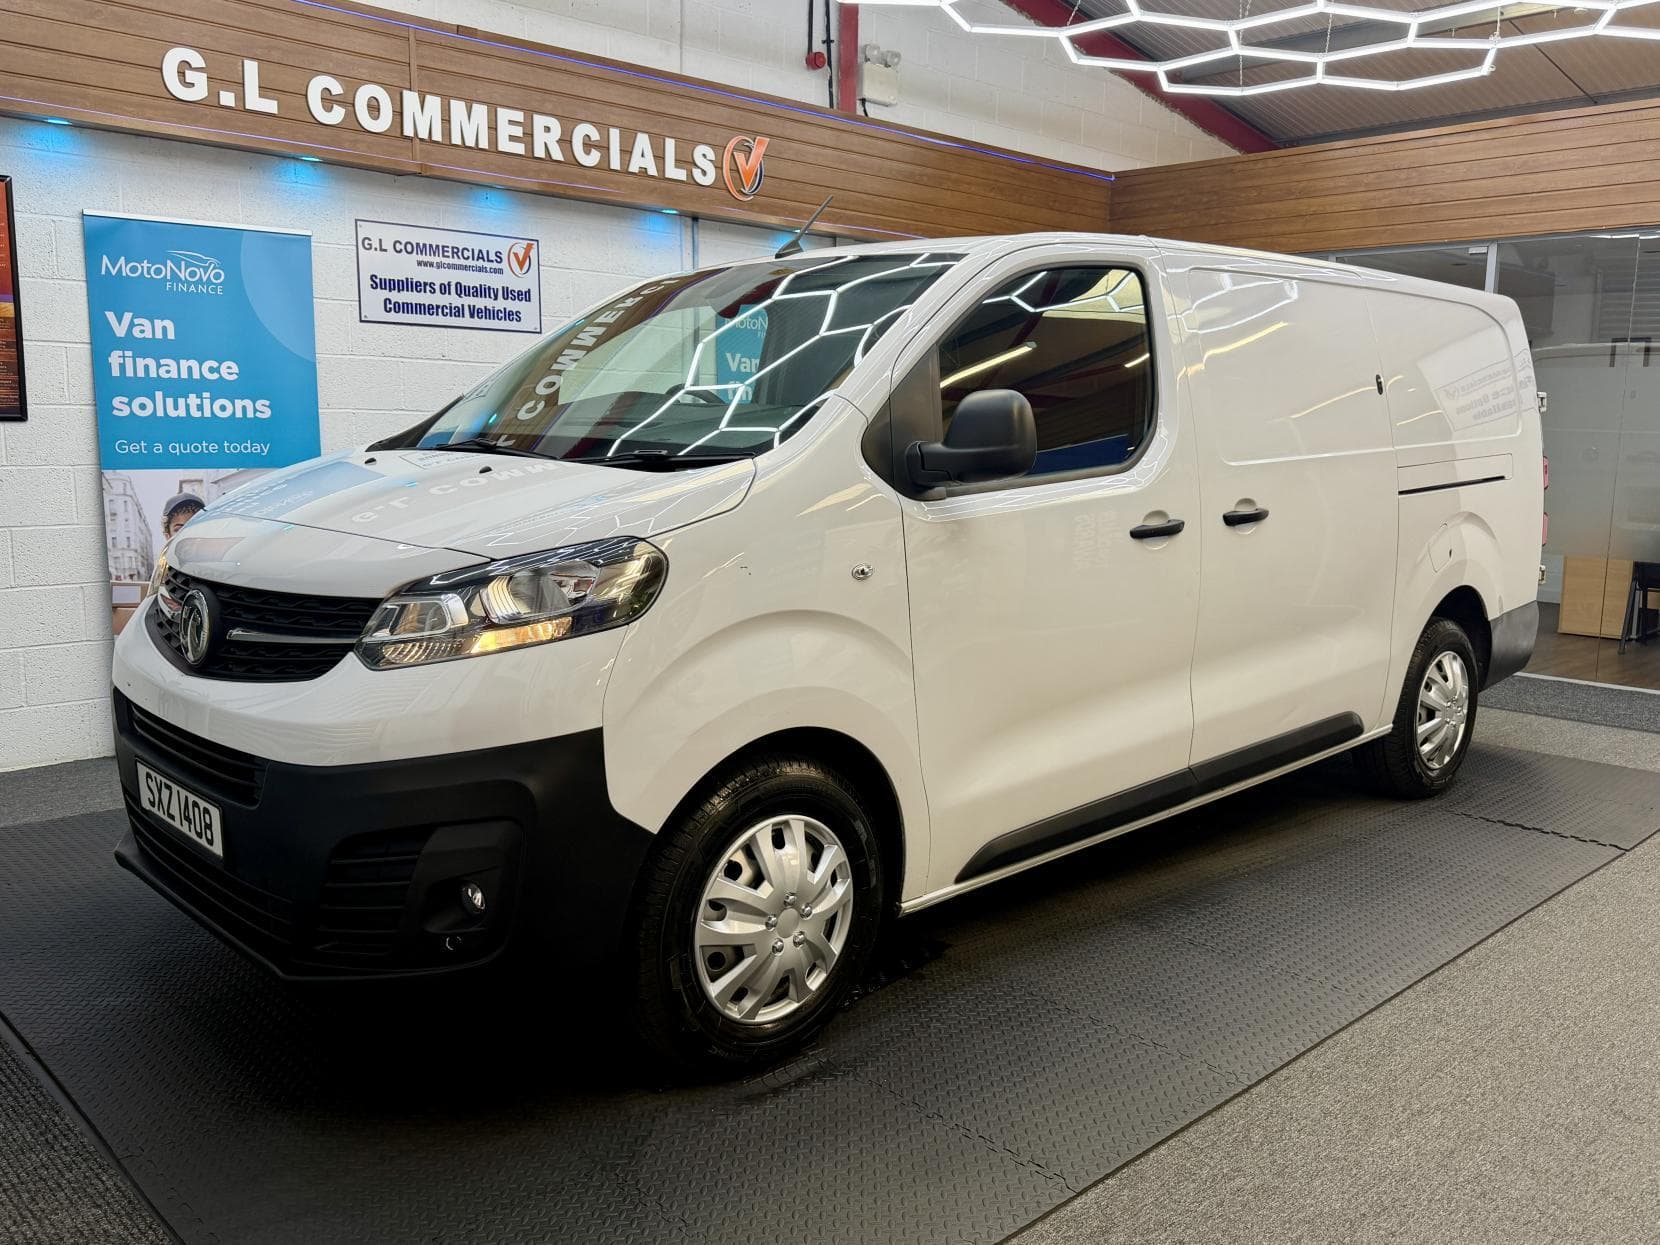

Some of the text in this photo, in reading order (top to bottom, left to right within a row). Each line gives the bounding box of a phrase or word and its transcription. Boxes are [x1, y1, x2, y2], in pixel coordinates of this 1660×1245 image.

[162, 47, 716, 186] G.L COMMERCIALS
[361, 236, 503, 264] G.L COMMERCIALS
[101, 254, 225, 284] MotoNovo
[416, 258, 504, 275] www.glcommercials.com
[166, 281, 224, 295] FINANCE
[370, 274, 531, 302] Suppliers of Quality Used
[383, 297, 522, 322] Commercial Vehicles
[104, 311, 175, 340] Van
[108, 350, 240, 381] finance
[111, 390, 272, 419] solutions
[115, 440, 270, 456] Get a quote today
